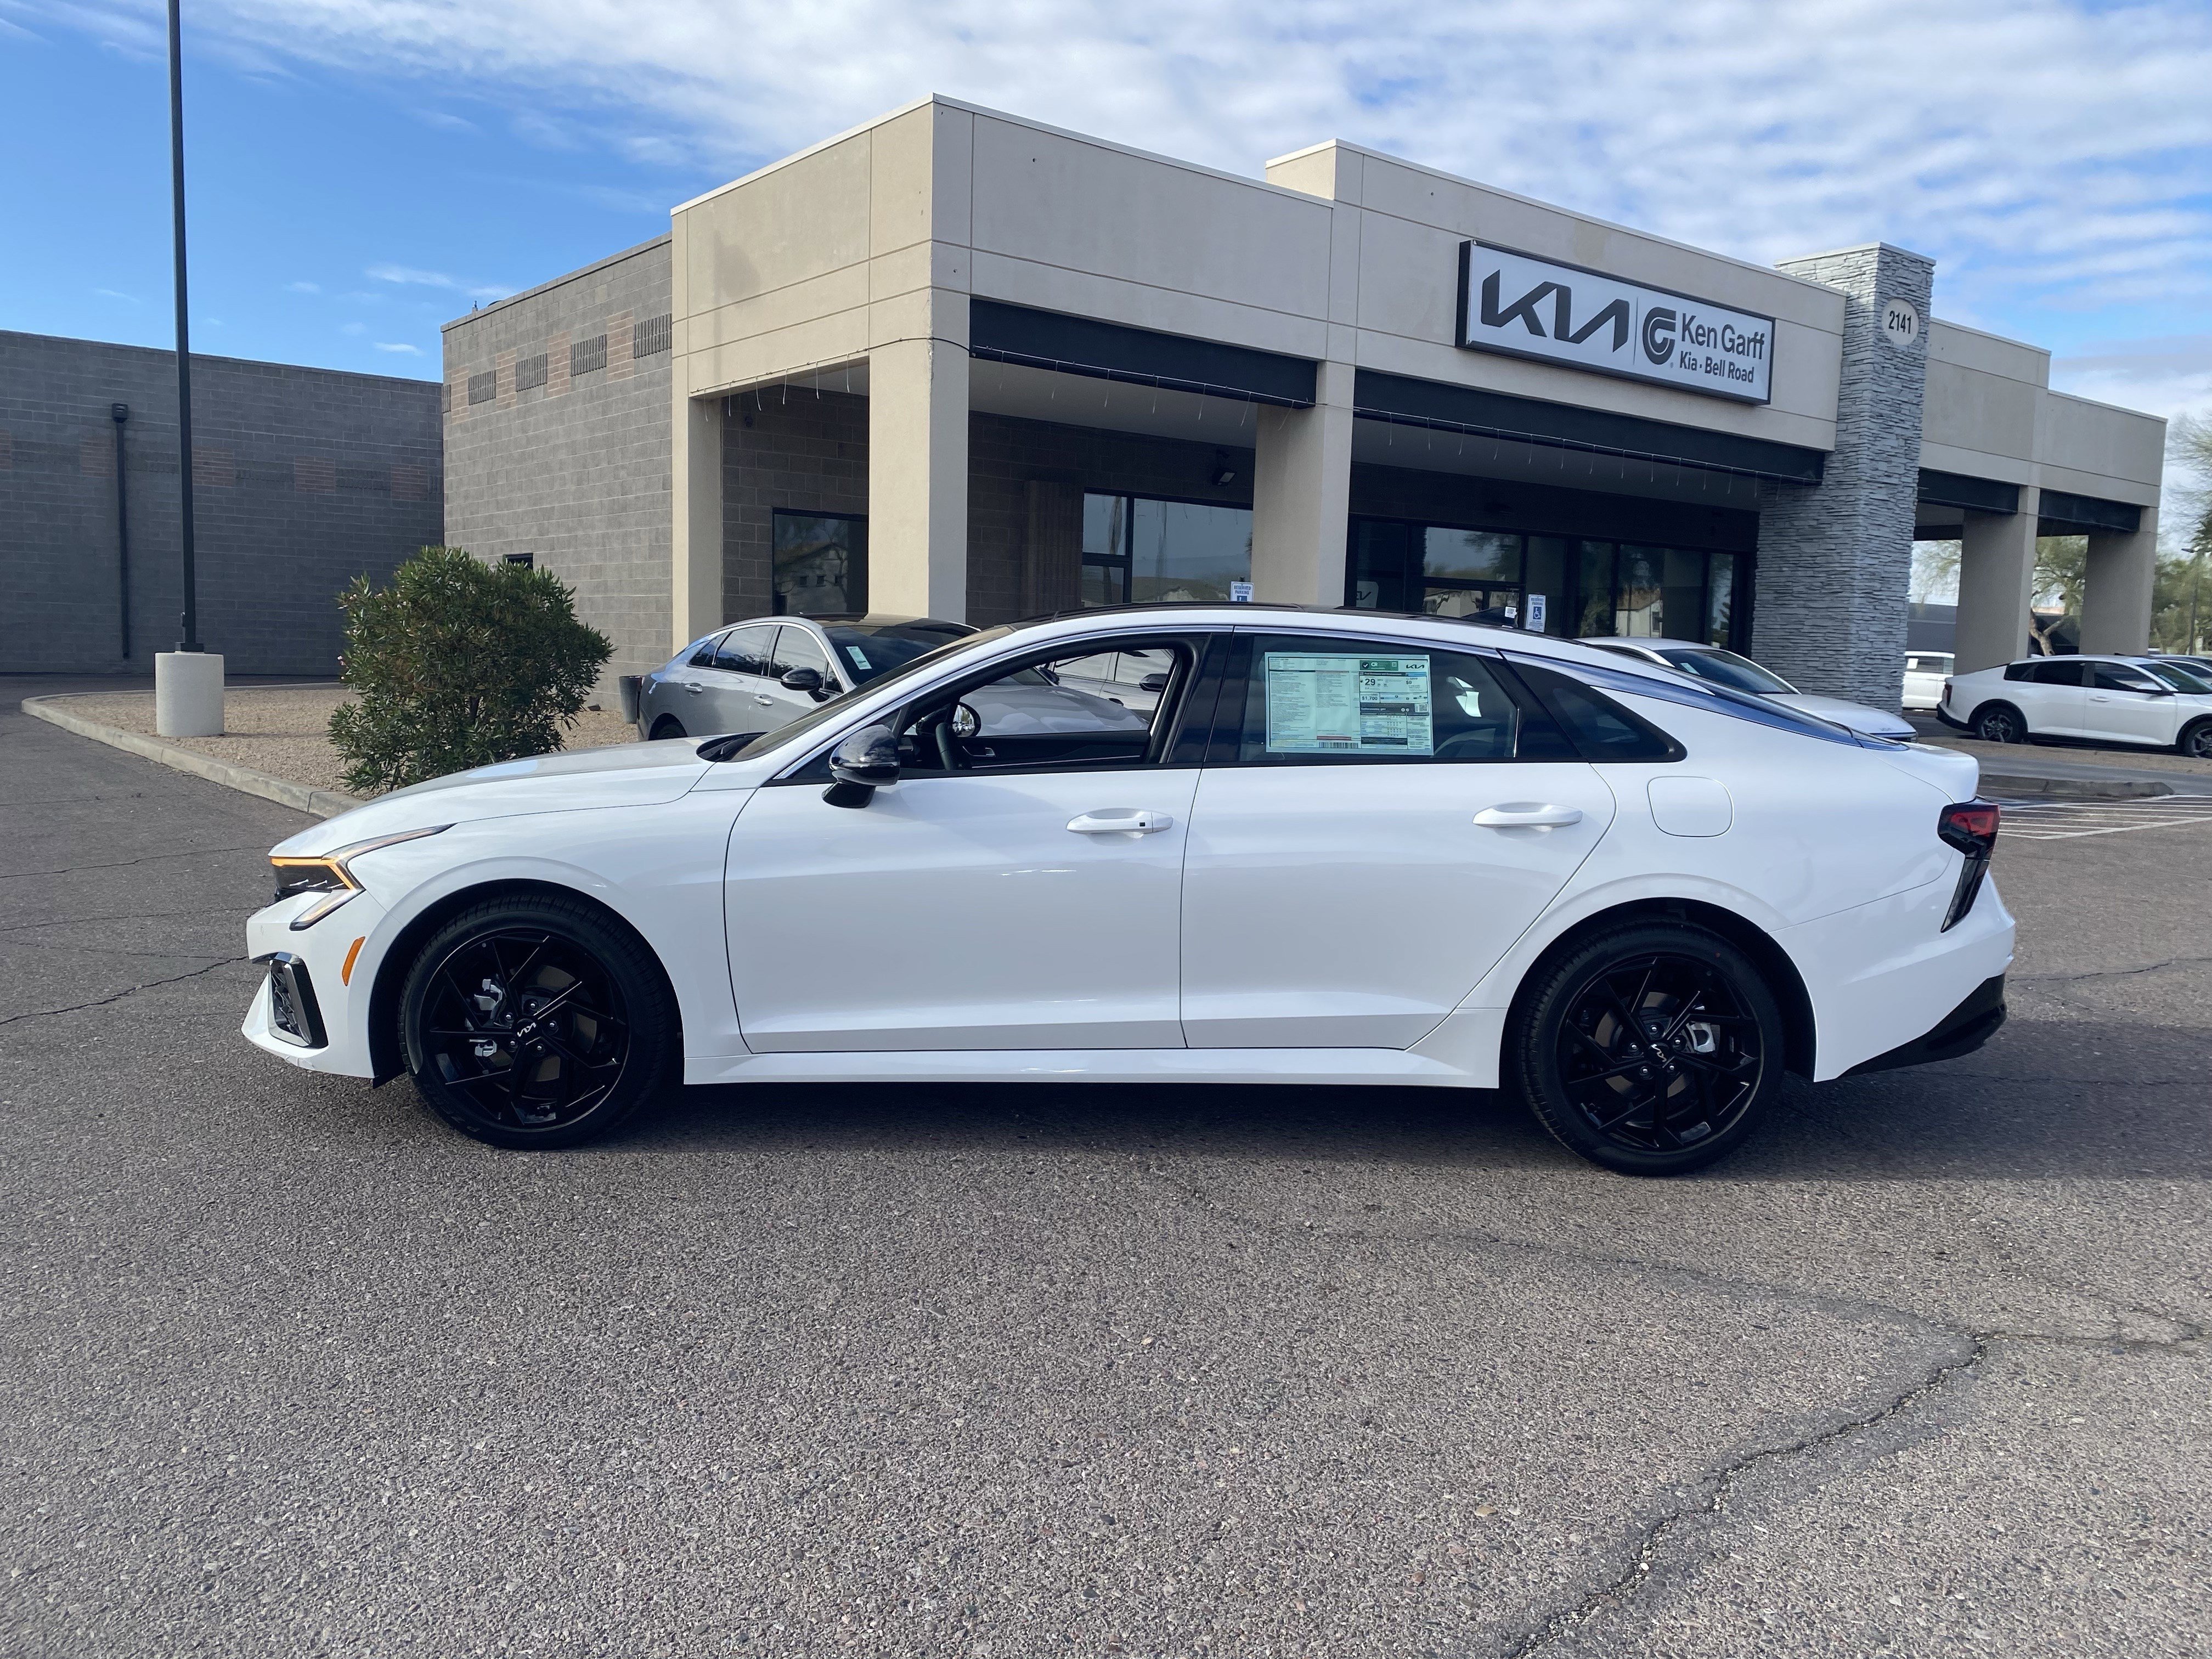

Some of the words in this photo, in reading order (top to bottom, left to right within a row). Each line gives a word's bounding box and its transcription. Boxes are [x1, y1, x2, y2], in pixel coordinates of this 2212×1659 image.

[1481, 269, 1630, 353] KIA
[1888, 310, 1912, 334] 2141
[1681, 313, 1718, 349] Ken
[1722, 324, 1765, 359] Garff
[1679, 351, 1697, 371] Kia
[1705, 356, 1726, 377] Bell
[1728, 361, 1754, 383] Road
